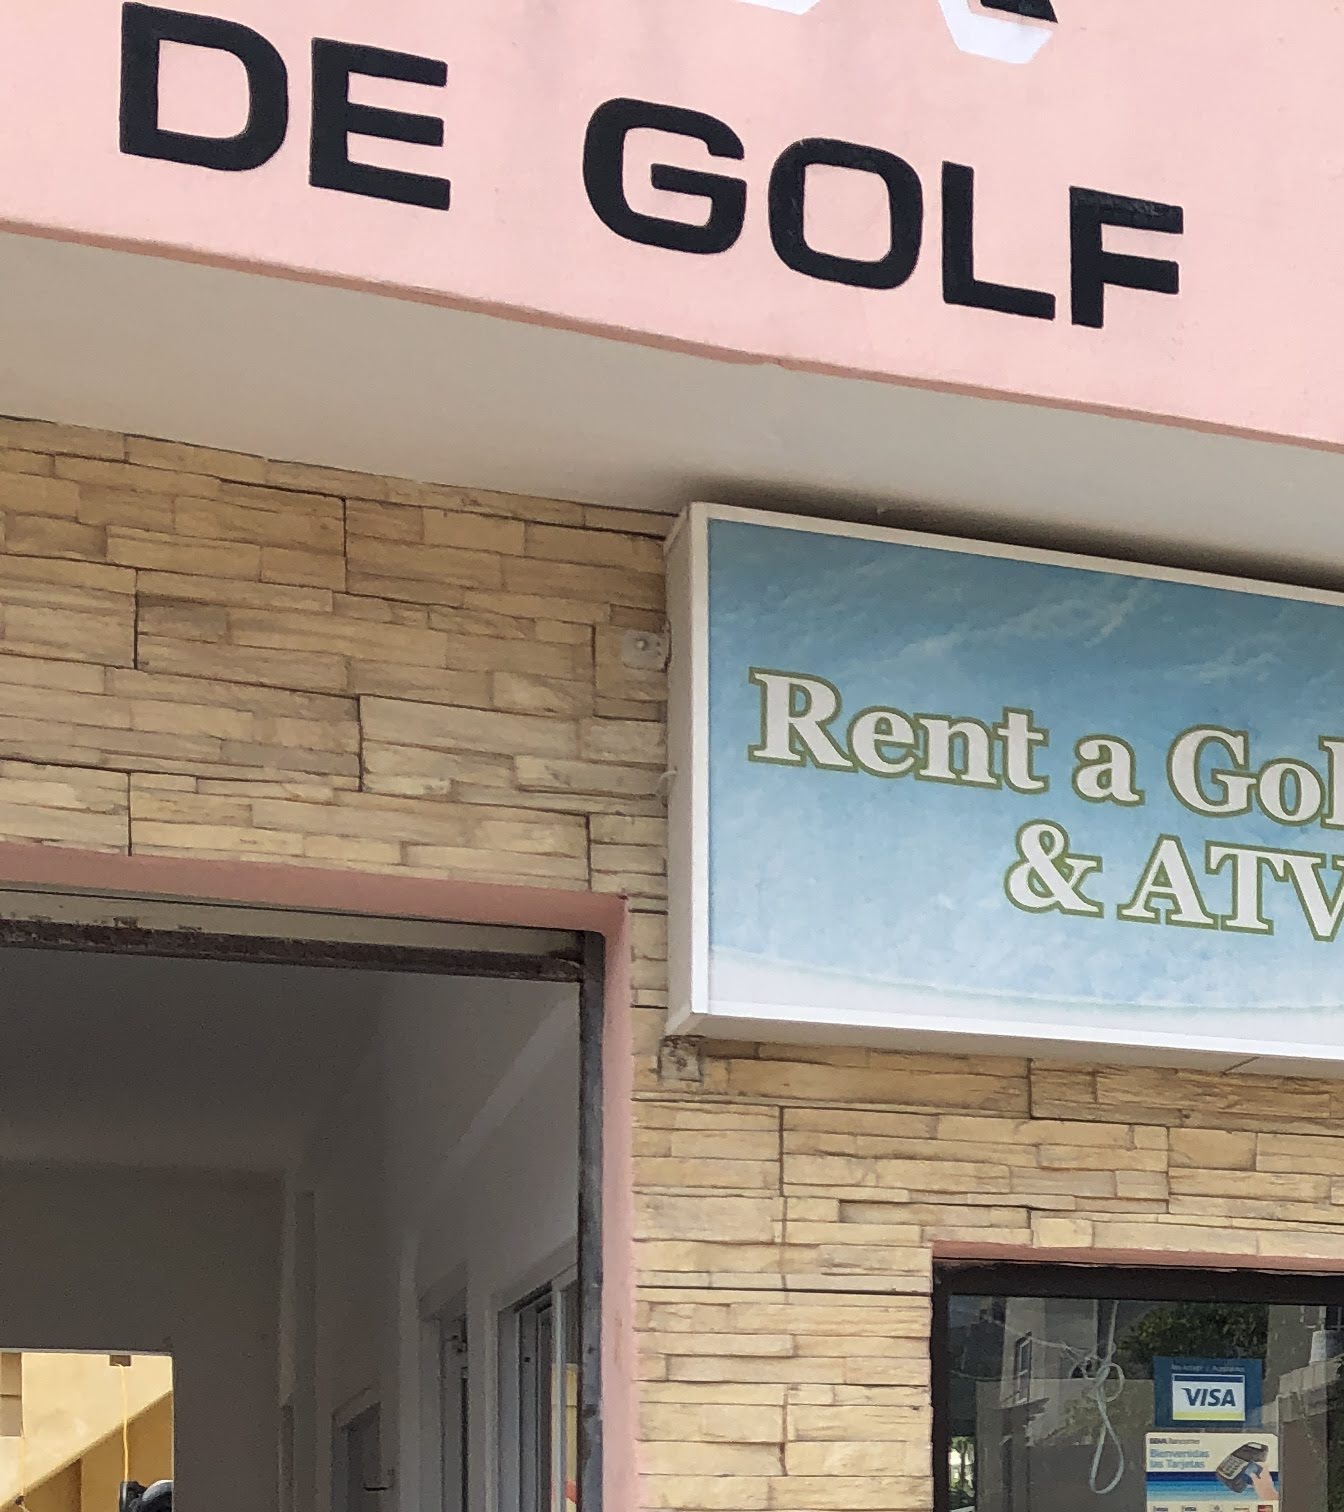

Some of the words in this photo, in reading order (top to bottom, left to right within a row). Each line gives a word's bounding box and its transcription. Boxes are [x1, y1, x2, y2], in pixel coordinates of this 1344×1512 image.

[119, 2, 451, 210] DE
[583, 97, 1185, 328] GOLF
[748, 666, 1049, 794] Rent
[1073, 731, 1144, 807] a
[1003, 819, 1104, 921] &
[1181, 1386, 1237, 1409] VISA
